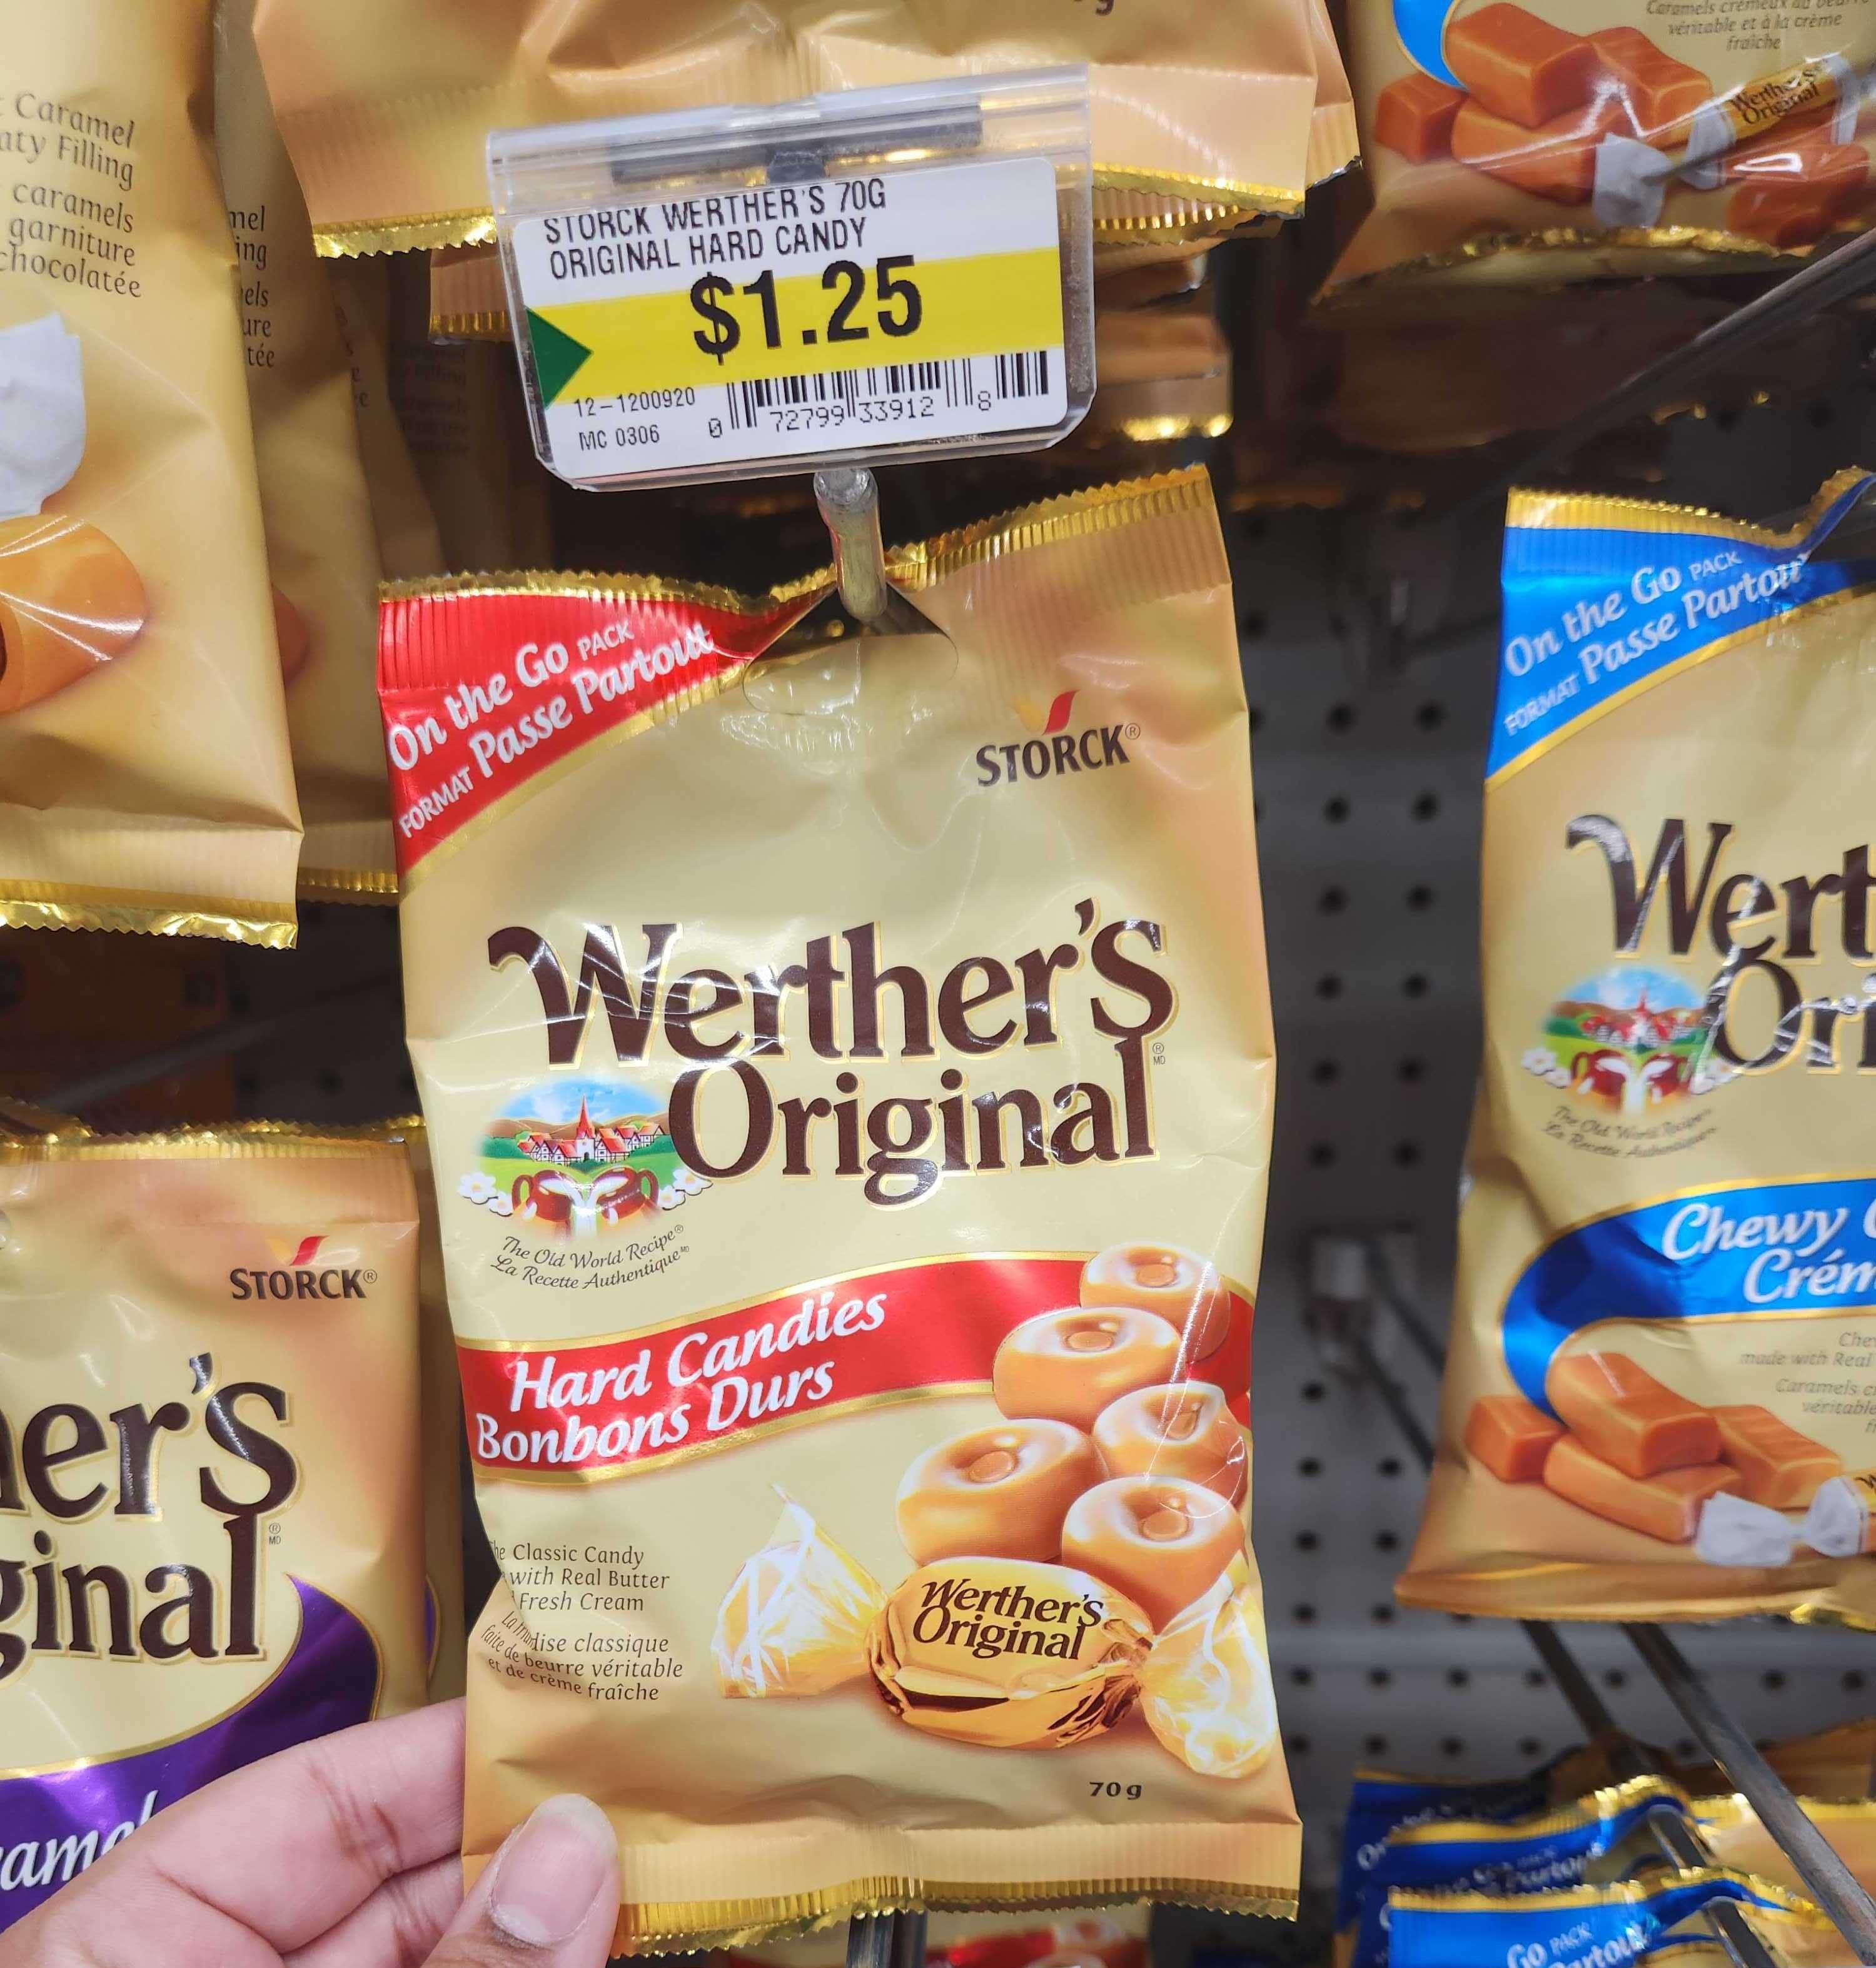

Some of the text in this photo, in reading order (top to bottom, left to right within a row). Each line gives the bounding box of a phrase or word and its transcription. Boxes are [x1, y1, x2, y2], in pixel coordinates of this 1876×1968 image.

[15, 92, 135, 149] Caramel
[58, 134, 133, 191] Filling
[13, 183, 134, 234] caramels
[544, 178, 887, 244] STORCK WERTHER'S 70G
[9, 217, 135, 267] garniture
[549, 216, 867, 280] ORIGINAL HARD CANDY
[690, 255, 923, 366] $1.25
[573, 386, 697, 418] 12-1200920
[708, 390, 992, 439] 0 72799 33912 8
[578, 424, 660, 452] MC 0306
[1505, 550, 1743, 677] On the Go PACK
[388, 619, 635, 770] On the Go PACK
[1504, 674, 1580, 737] FORMAT
[1578, 610, 1681, 685] Passe
[399, 621, 714, 839] FORMAT Passe Partout
[1566, 814, 1876, 961] Wert
[488, 897, 1179, 1066] Werther's
[668, 1037, 1162, 1209] Original
[502, 1236, 530, 1259] The
[534, 1249, 565, 1268] Old
[570, 1249, 623, 1269] World
[1662, 1202, 1849, 1262] Chewy
[490, 1254, 518, 1276] La
[522, 1265, 579, 1289] Recette
[1743, 1248, 1876, 1304] Crém
[510, 1292, 889, 1413] Hard Candies
[1833, 1351, 1872, 1368] Real
[476, 1360, 835, 1464] Bonbons Durs
[1775, 1378, 1858, 1396] Caramels
[510, 1566, 554, 1585] with
[562, 1568, 601, 1585] Real
[609, 1570, 670, 1589] Butter
[513, 1543, 577, 1561] Classic
[585, 1545, 644, 1570] Candy
[520, 1590, 572, 1611] Fresh
[580, 1592, 644, 1612] Cream
[922, 1578, 1104, 1628] Werther's
[481, 1624, 683, 1678] faite de beurre véritable
[502, 1611, 518, 1630] La
[574, 1633, 669, 1658] classique
[912, 1605, 1087, 1660] Original
[488, 1658, 660, 1700] et de crème fraîche
[1089, 1782, 1142, 1800] 70 g
